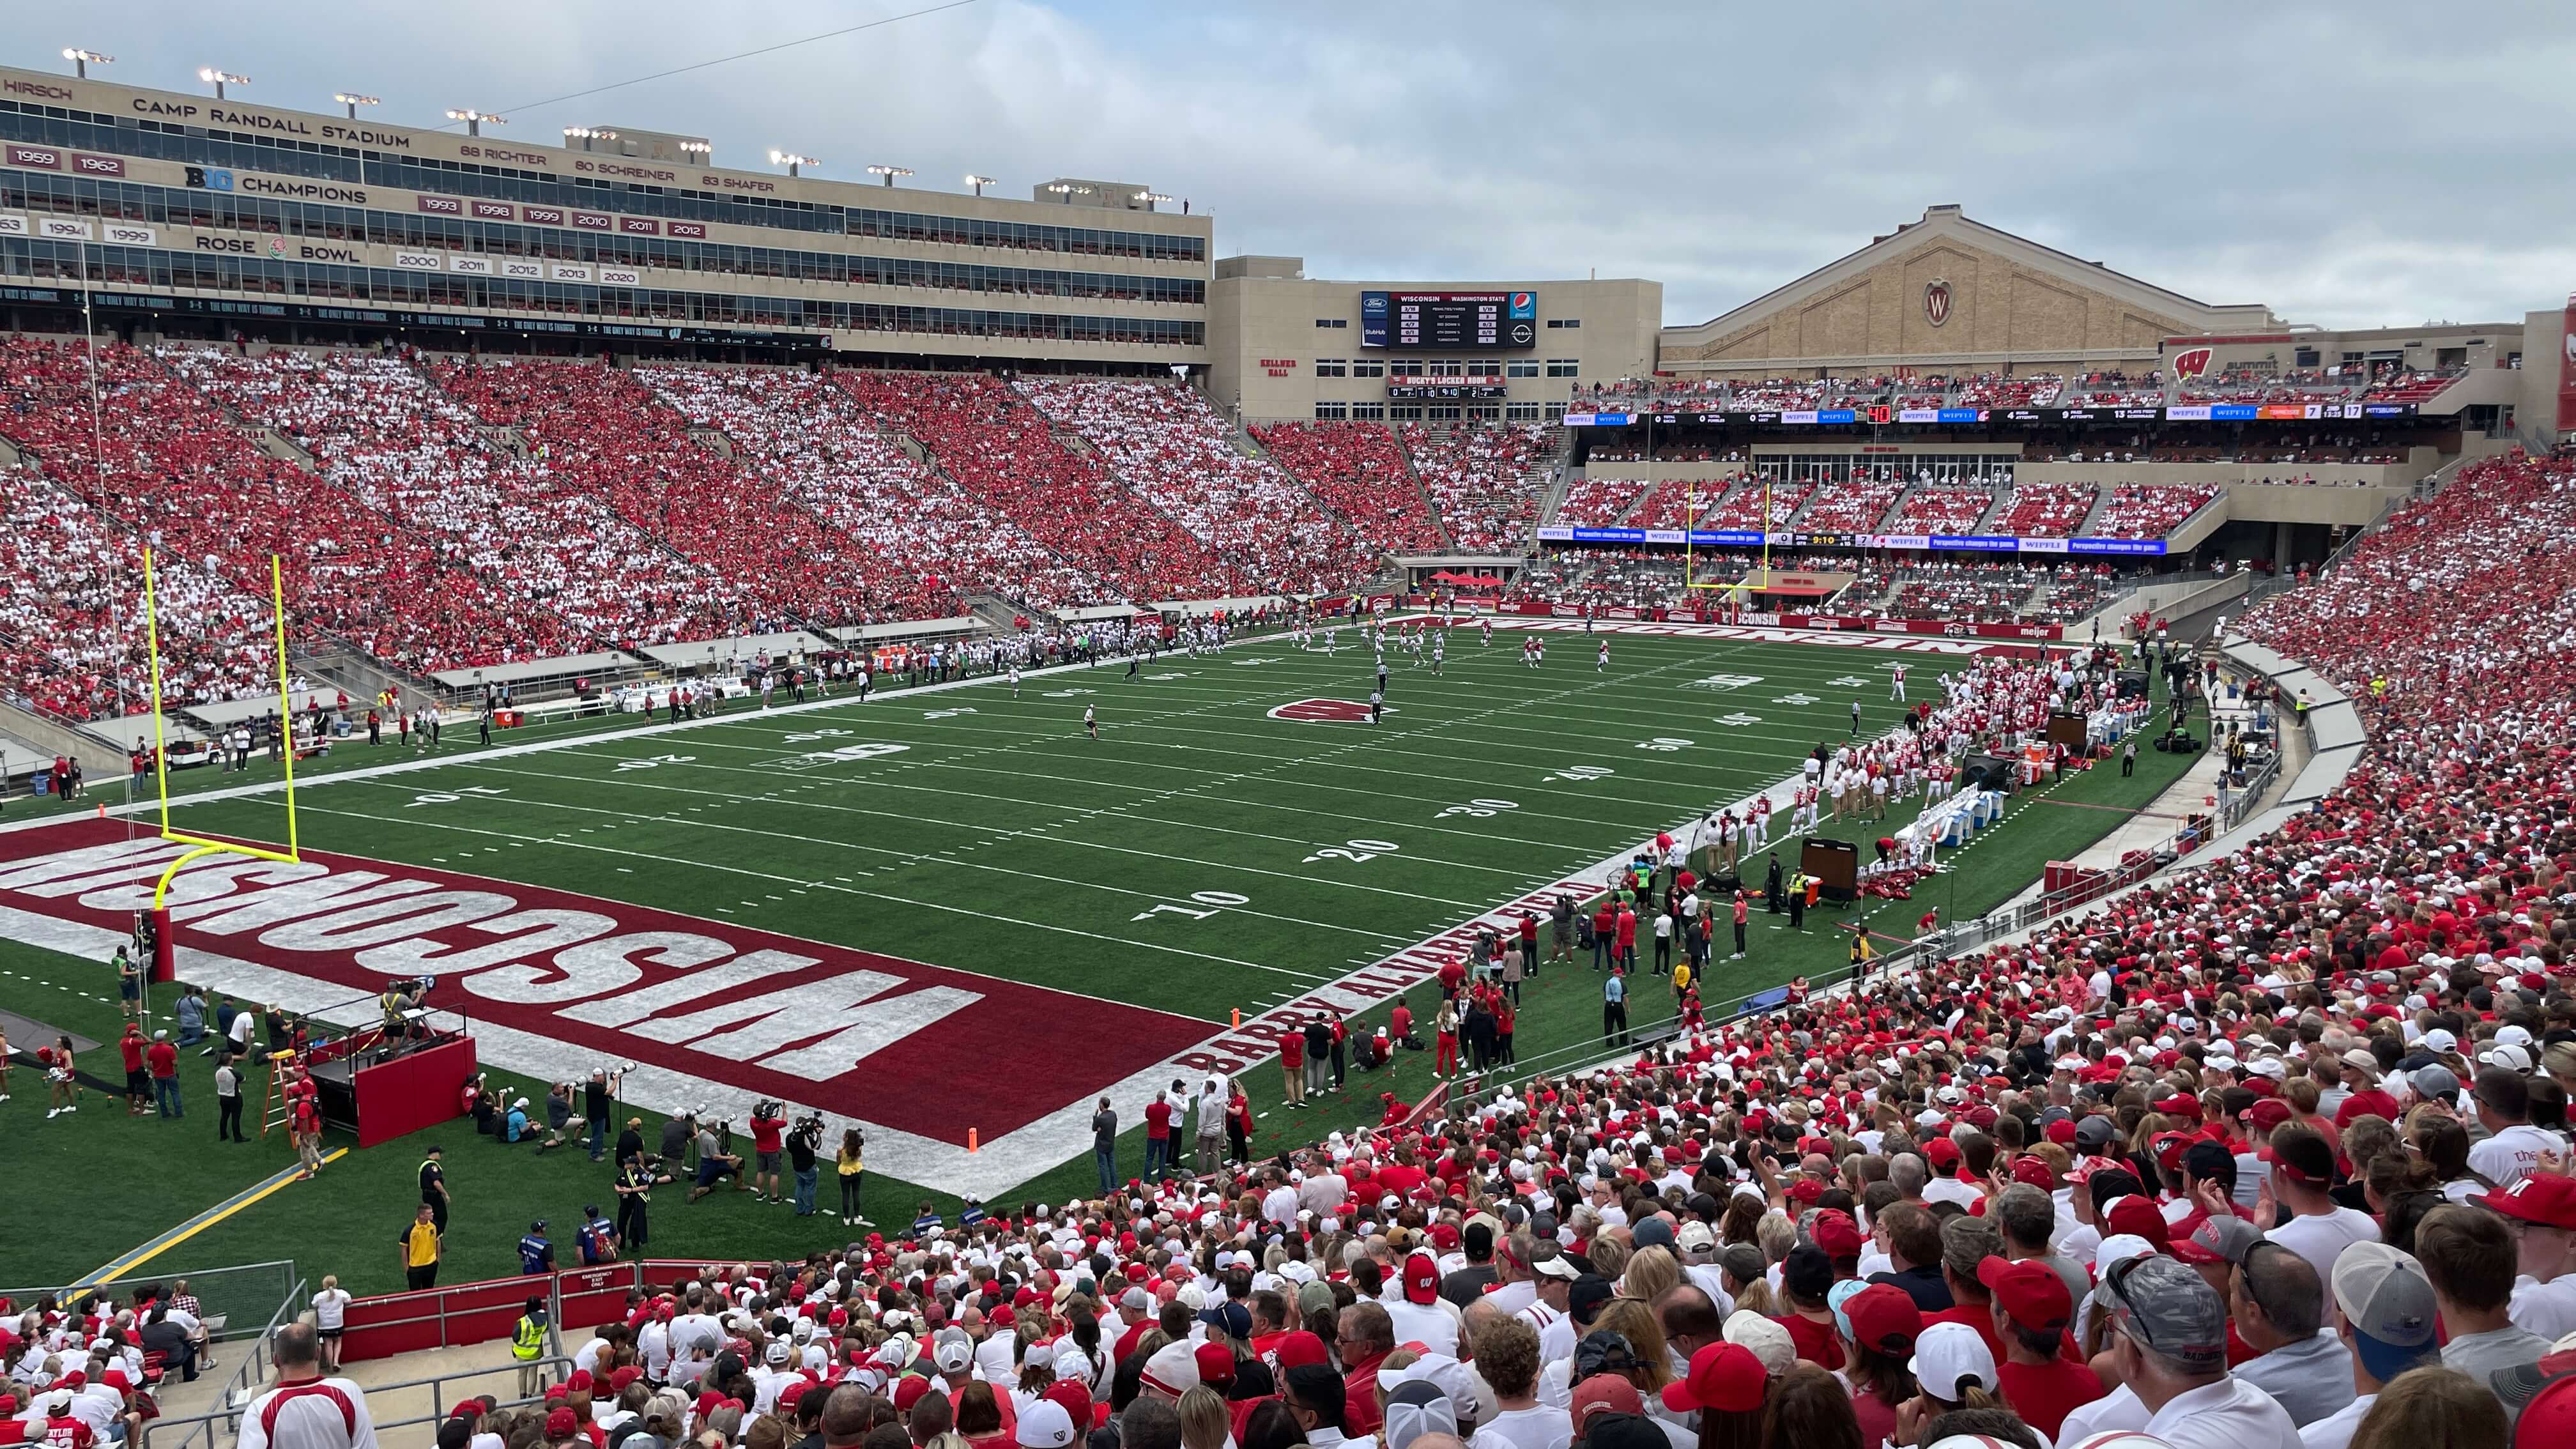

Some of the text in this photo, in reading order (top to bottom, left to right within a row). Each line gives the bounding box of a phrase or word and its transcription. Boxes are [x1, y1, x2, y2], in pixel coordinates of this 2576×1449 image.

[4, 79, 72, 100] HIRSCH
[133, 99, 410, 148] CAMP RANDALL STADIUM
[16, 150, 55, 165] 1959
[460, 146, 547, 165] 88 RICHTER
[80, 158, 119, 172] 1962
[576, 160, 675, 182] 80 SCHREINER
[702, 176, 774, 192] 83 SHAFER
[242, 178, 367, 204] CHAMPIONS
[424, 199, 457, 212] 1993
[478, 204, 510, 217] 1998
[530, 210, 560, 222] 1999
[578, 215, 608, 226] 2010
[49, 223, 86, 236] 1994
[628, 220, 652, 231] 2011
[674, 225, 701, 236] 2012
[112, 229, 149, 241] 1999
[196, 236, 360, 263] ROSE BOWL
[399, 256, 438, 267] 2000
[459, 261, 485, 271] 2011
[509, 264, 537, 275] 2012
[558, 268, 586, 279] 2013
[604, 273, 636, 282] 2020
[1929, 293, 1947, 318] W
[2227, 358, 2279, 369] summit
[1268, 369, 1288, 377] HALL
[1407, 376, 1436, 385] BUCKY'S
[1438, 376, 1465, 385] LOCKER
[1869, 406, 1889, 422] 40
[2062, 411, 2069, 419] 9
[2115, 410, 2125, 418] 13
[2310, 408, 2316, 417] 7
[2348, 406, 2359, 415] 17
[1499, 602, 1521, 612] meijer
[2020, 626, 2049, 638] meijer
[1634, 737, 1695, 751] 50
[617, 754, 696, 769] 20
[1555, 765, 1615, 781] 40
[415, 785, 510, 803] 10
[1445, 798, 1519, 817] 30
[1315, 839, 1399, 863] 20
[1151, 890, 1250, 921] 10
[1170, 997, 1356, 1075] BARRY
[1333, 921, 1521, 999] ALVAREZ
[2513, 1150, 2536, 1162] the
[582, 1271, 613, 1280] EMERGENCY
[1420, 1276, 1433, 1288] W
[47, 1427, 73, 1438] AYLOR
